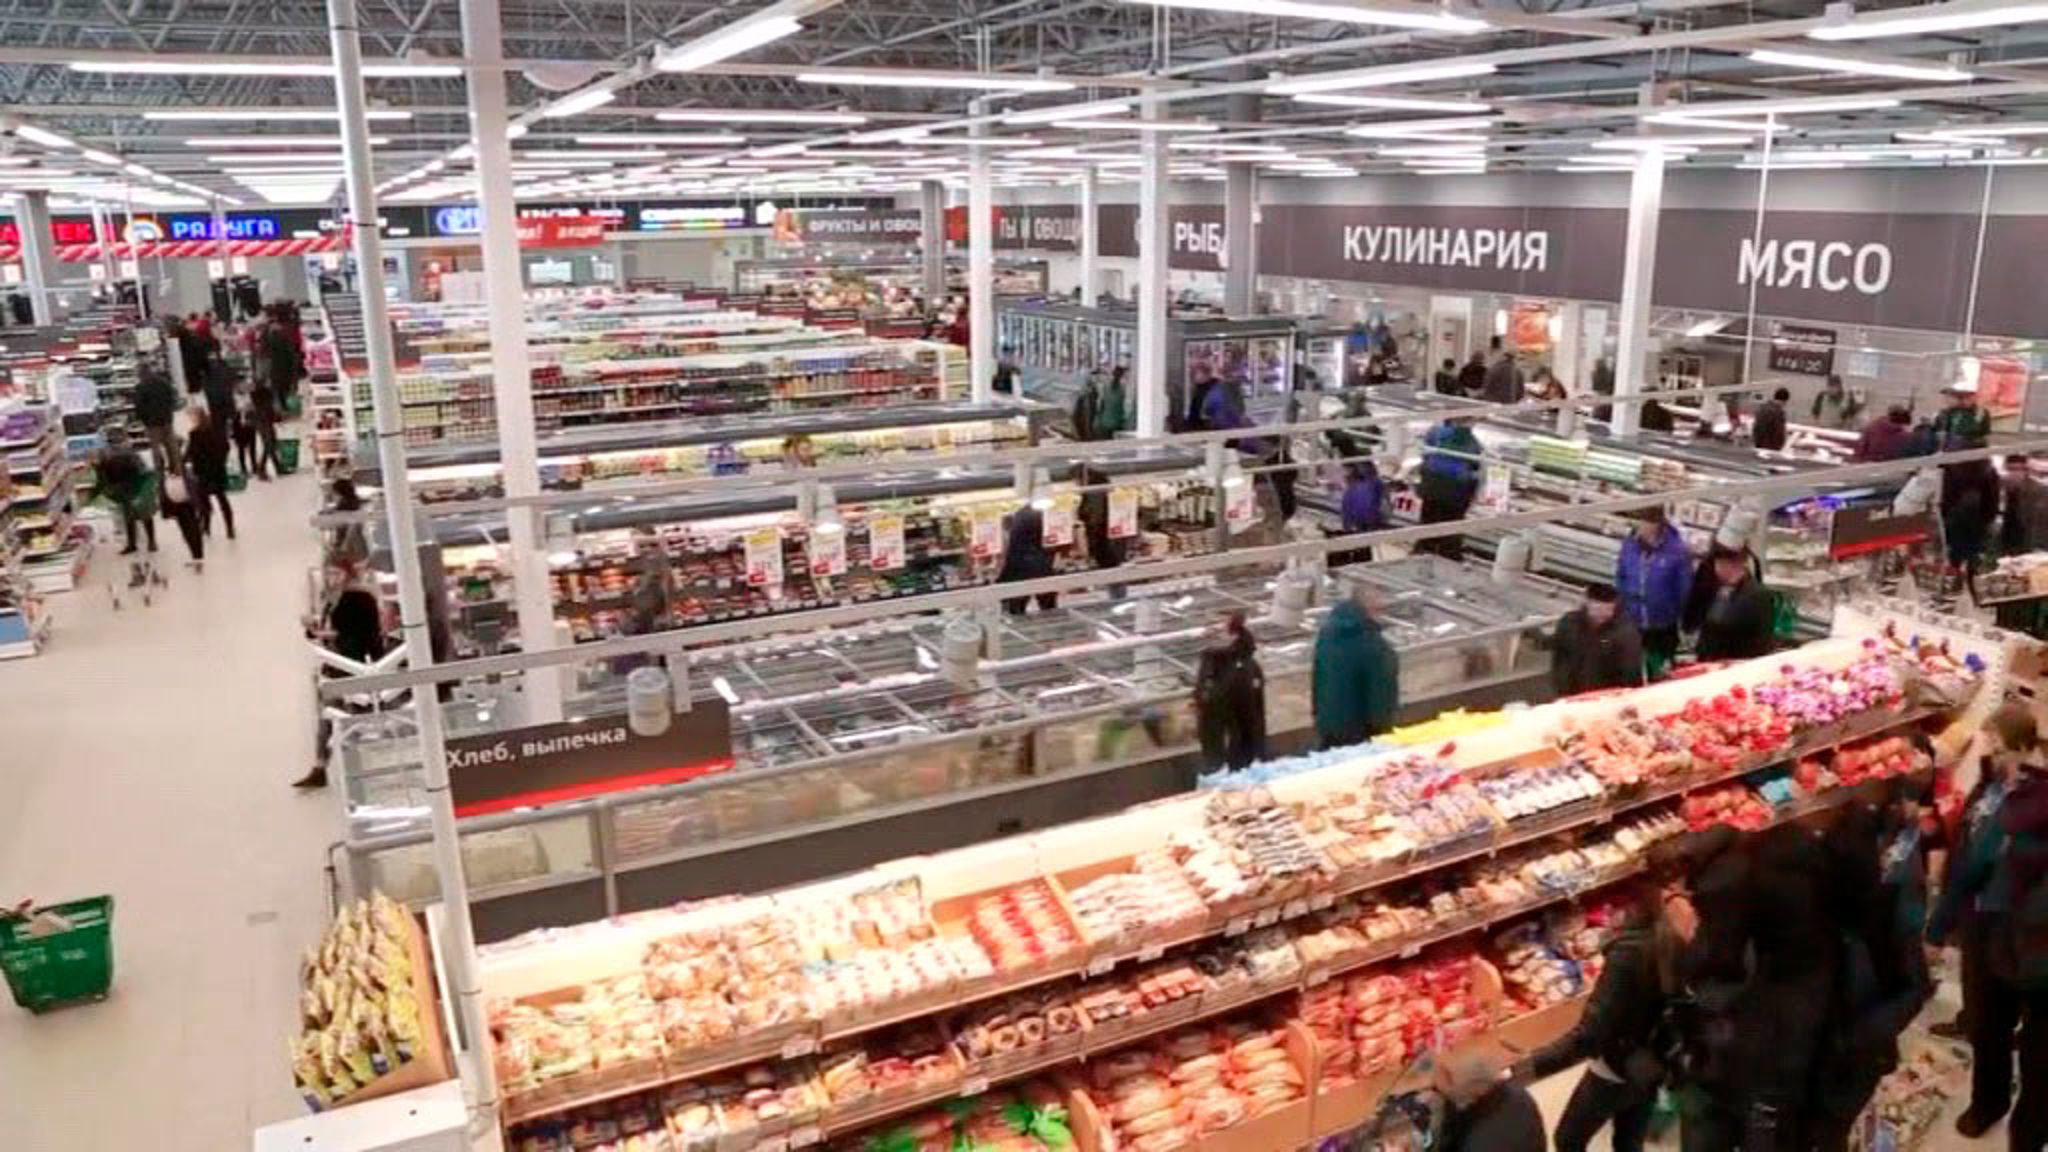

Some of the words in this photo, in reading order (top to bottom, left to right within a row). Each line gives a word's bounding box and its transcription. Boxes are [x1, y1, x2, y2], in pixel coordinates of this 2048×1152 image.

[809, 219, 867, 233] ФРУКТЫ
[869, 219, 881, 232] И
[1343, 225, 1548, 272] КУЛИНАРИЯ
[1737, 239, 1892, 294] МЯСО
[521, 727, 627, 757] выпечка
